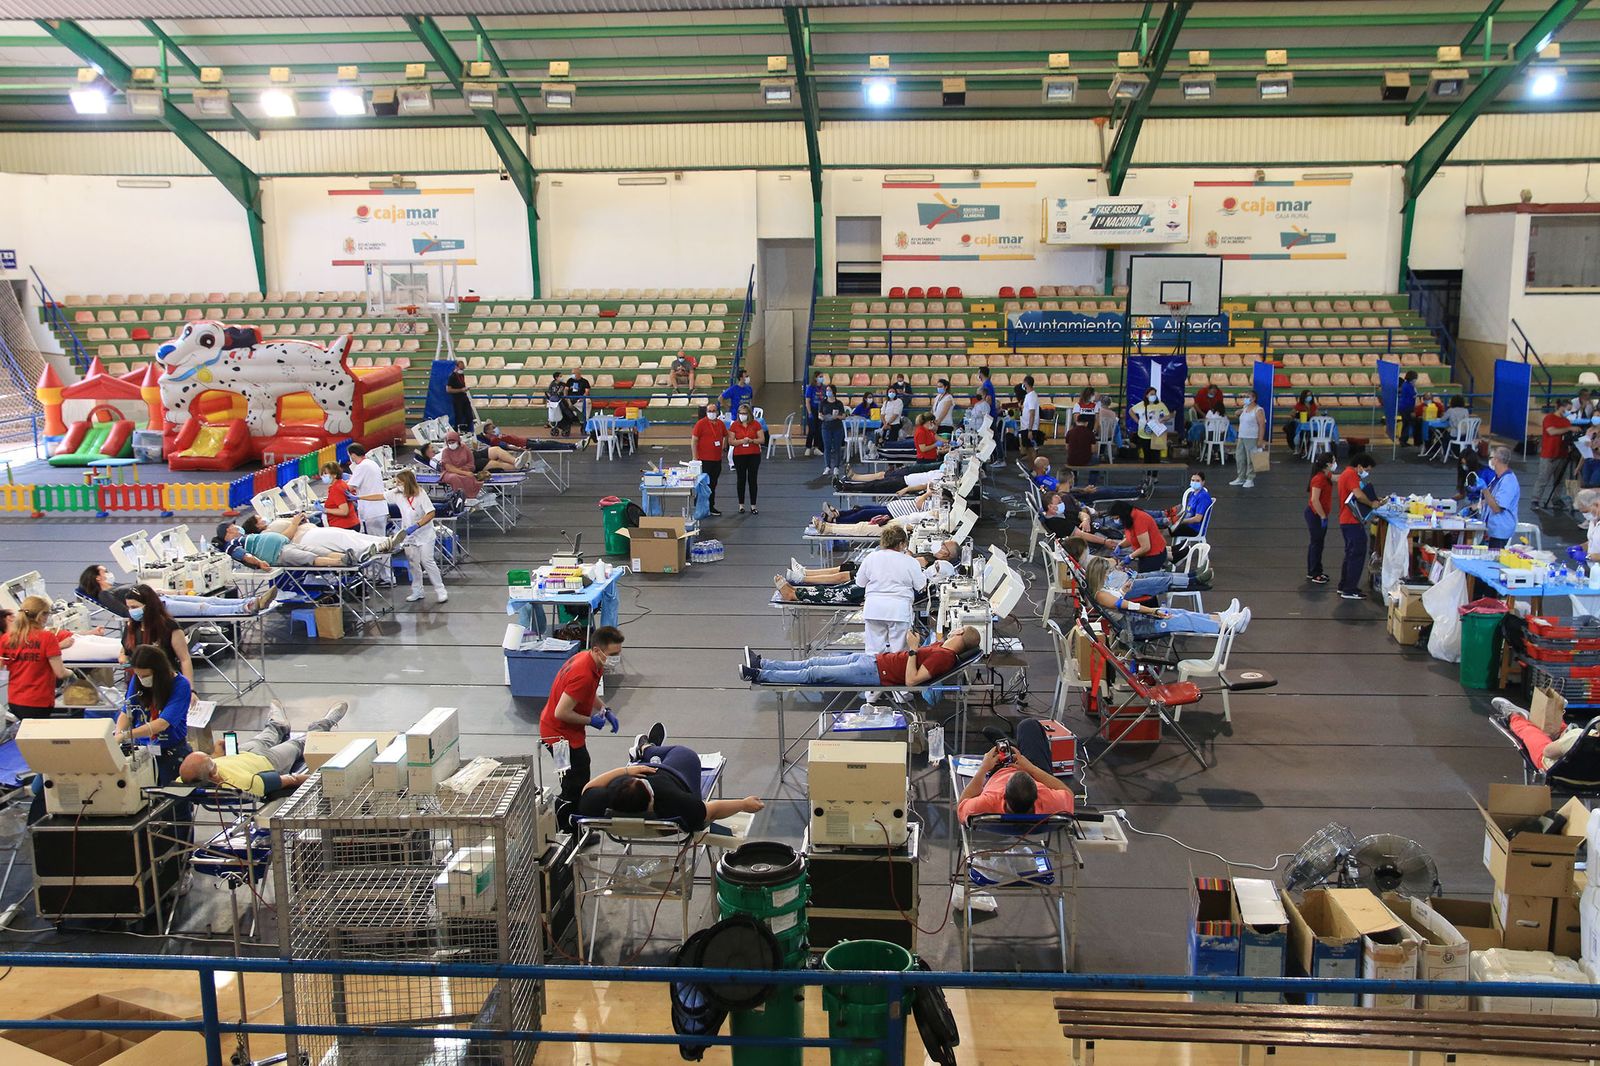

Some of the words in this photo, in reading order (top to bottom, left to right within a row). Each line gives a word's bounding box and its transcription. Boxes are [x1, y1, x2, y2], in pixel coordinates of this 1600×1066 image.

[1095, 205, 1112, 214] FASE
[1111, 205, 1139, 214] ASCENSO
[1240, 196, 1312, 216] cajamar
[373, 205, 439, 224] cajamar
[1103, 216, 1143, 227] NACIONAL
[974, 234, 1024, 247] cajamar
[1015, 319, 1122, 335] Ayuntamiento
